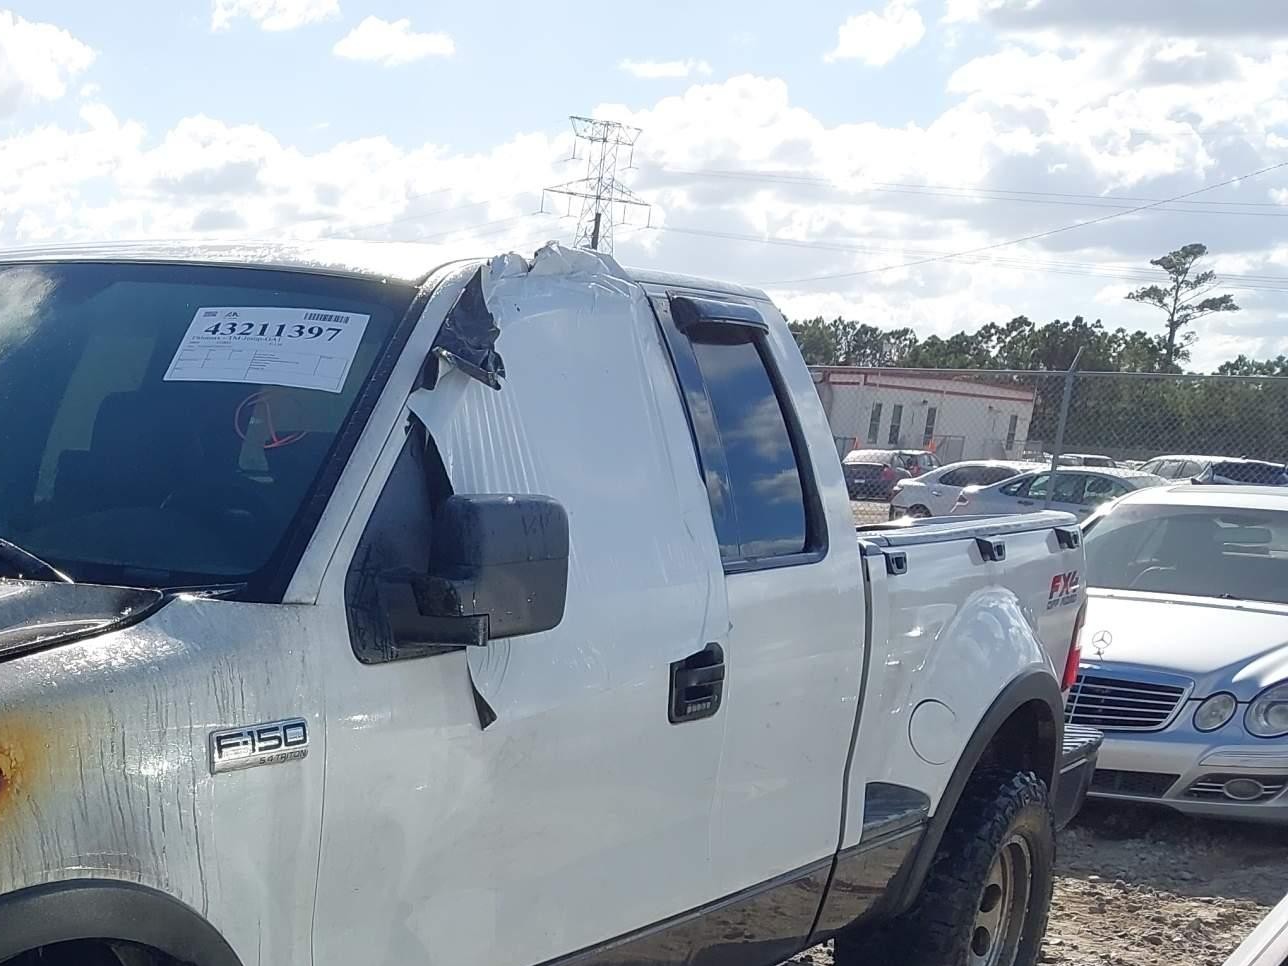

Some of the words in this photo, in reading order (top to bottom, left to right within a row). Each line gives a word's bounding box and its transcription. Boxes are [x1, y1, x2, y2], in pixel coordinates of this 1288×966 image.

[204, 321, 343, 342] 43211397
[1048, 569, 1080, 600] FX4
[215, 721, 308, 760] F-150
[274, 749, 309, 763] TRITON
